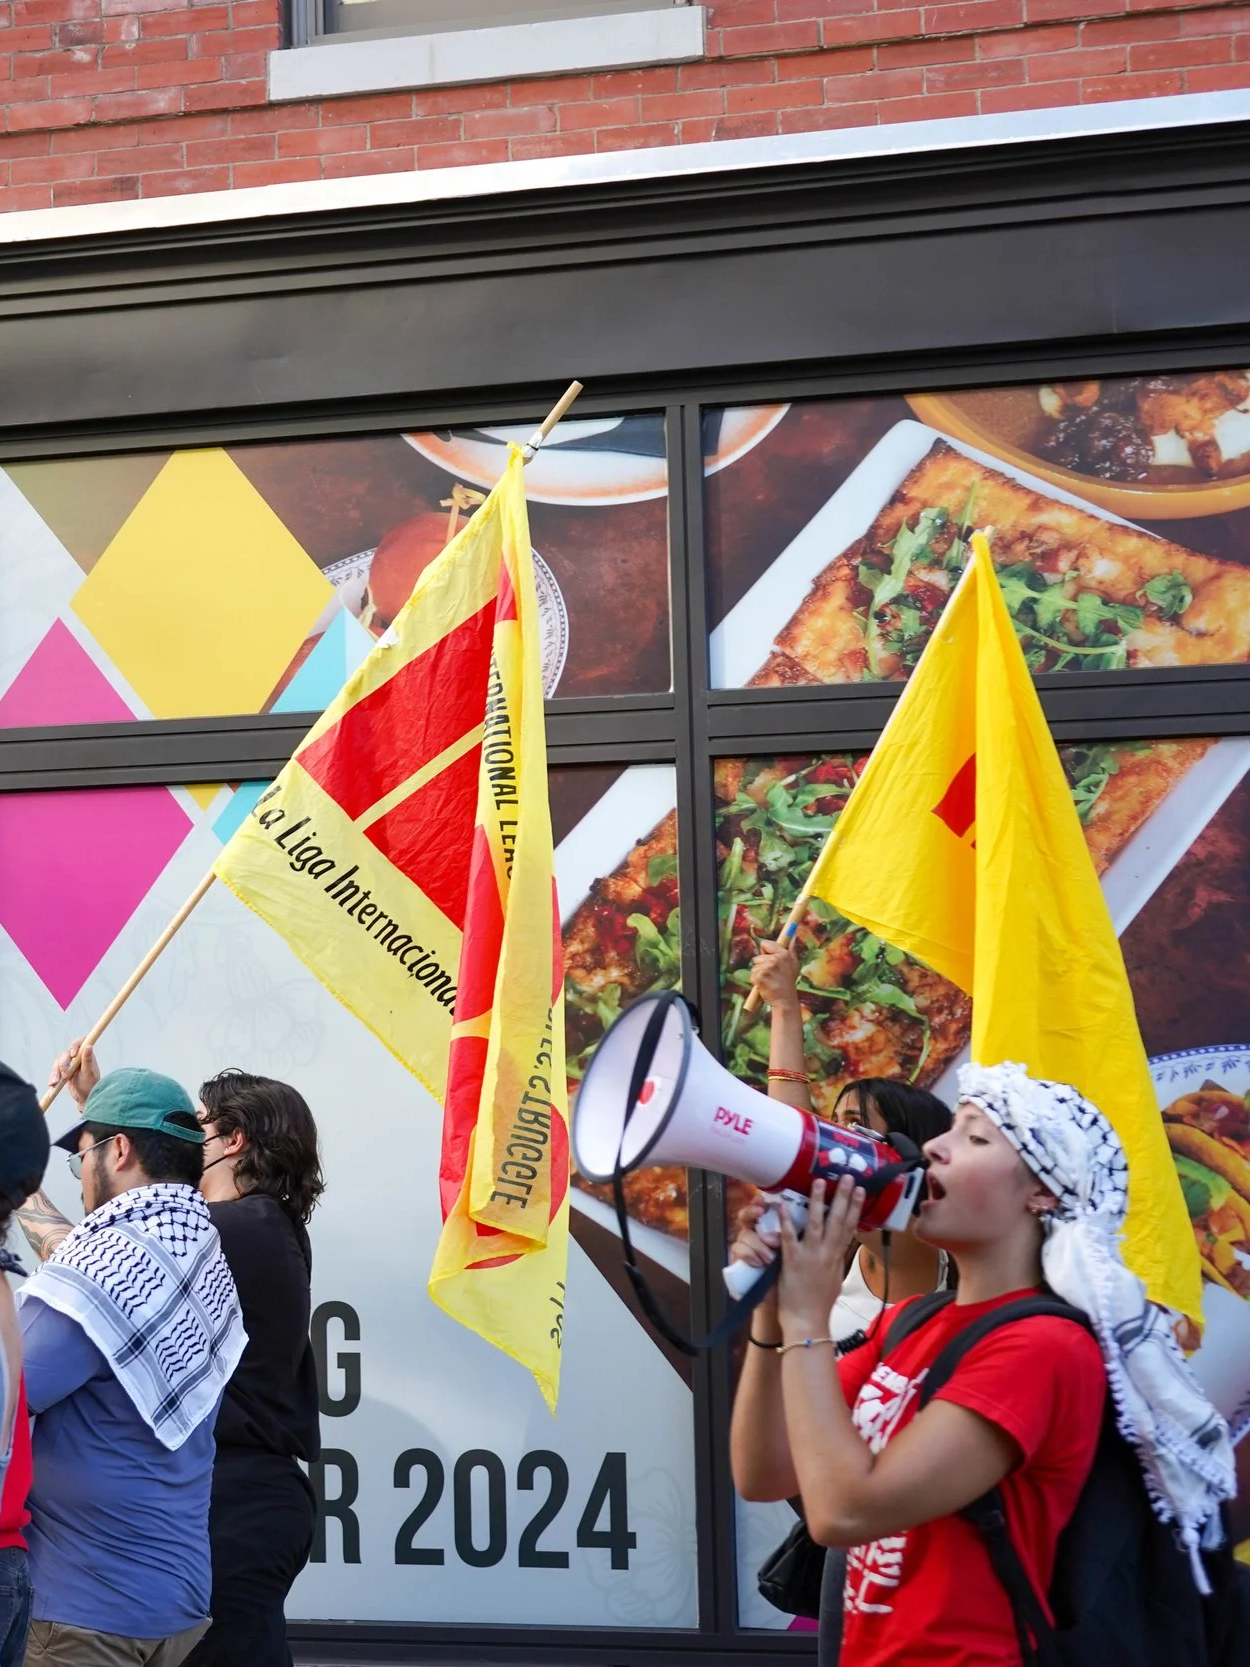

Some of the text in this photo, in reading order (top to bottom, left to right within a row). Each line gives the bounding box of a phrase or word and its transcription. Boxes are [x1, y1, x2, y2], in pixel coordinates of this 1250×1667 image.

[273, 815, 336, 880] Liga
[323, 864, 458, 1017] Internaciona
[392, 1447, 638, 1571] 2024
